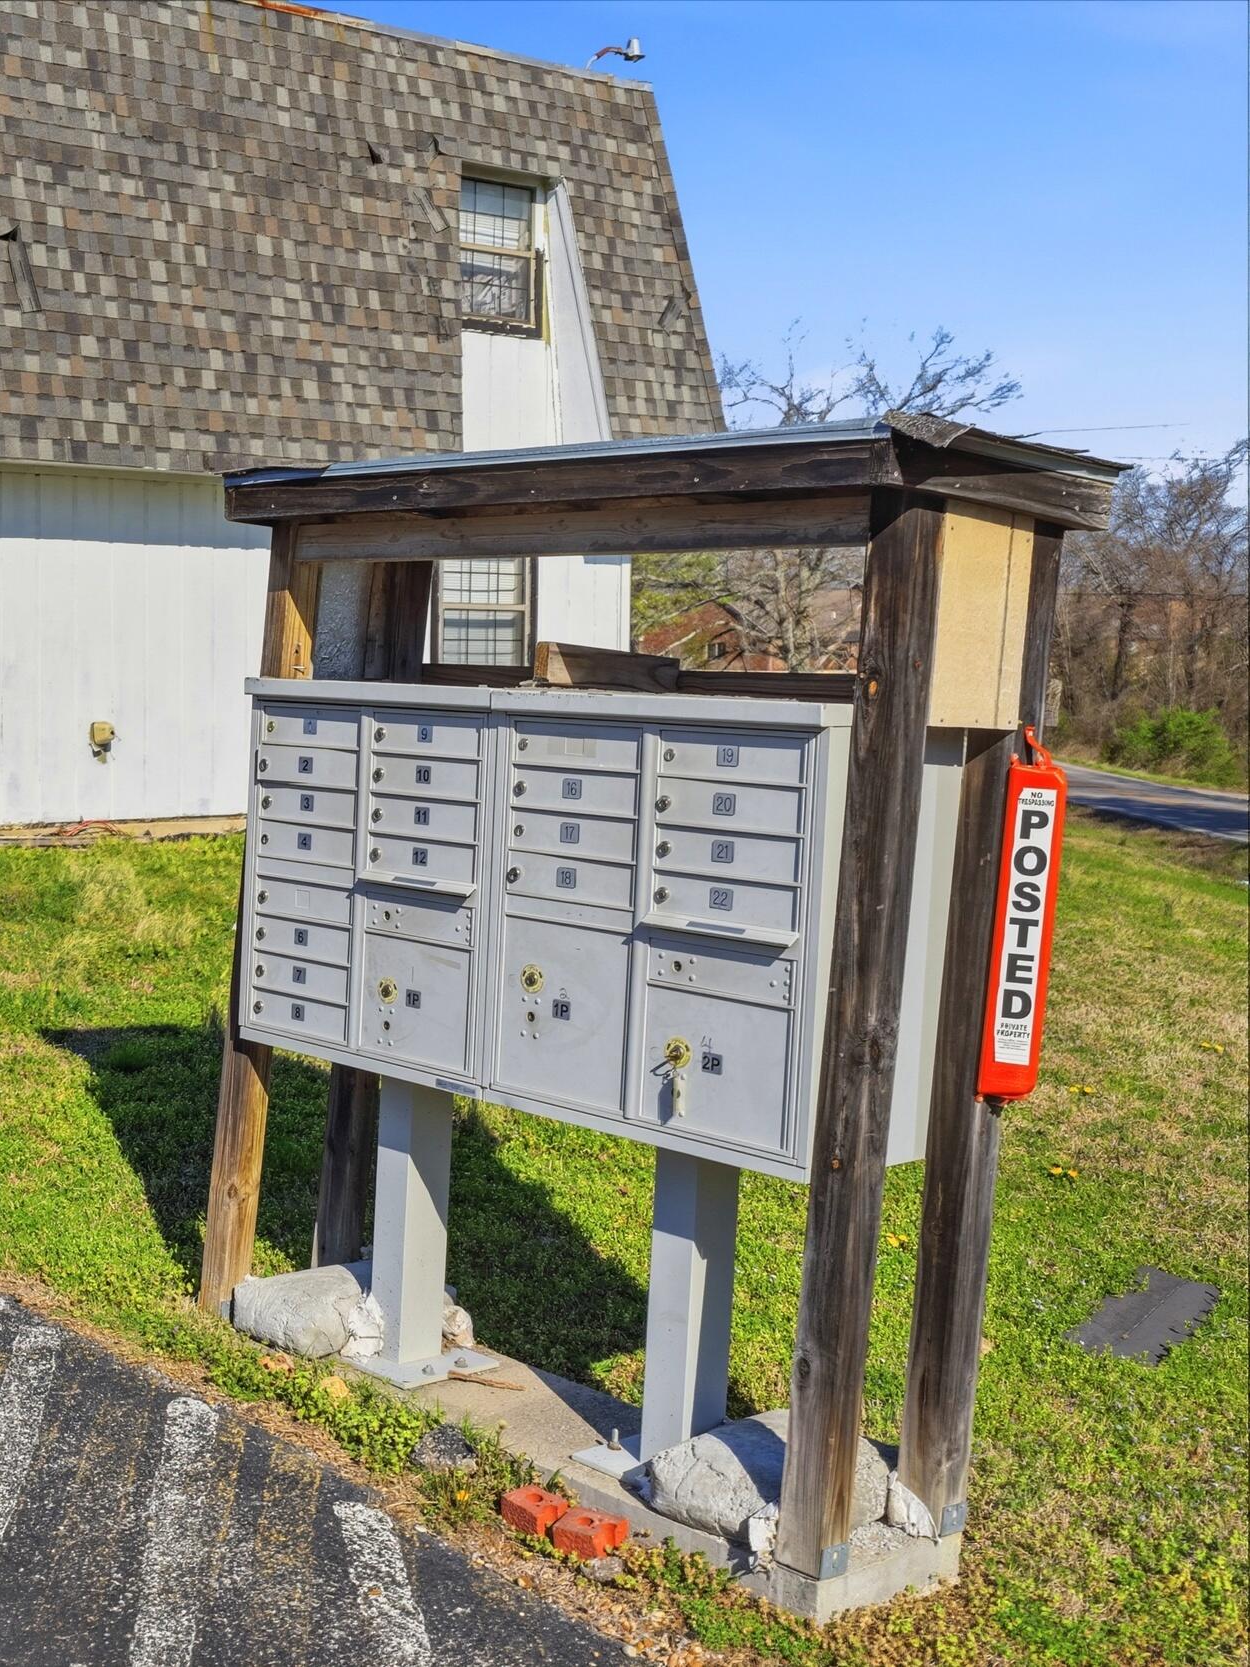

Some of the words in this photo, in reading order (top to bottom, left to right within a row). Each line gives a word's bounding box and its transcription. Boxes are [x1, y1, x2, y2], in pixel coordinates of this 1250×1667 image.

[1030, 791, 1043, 799] NO
[1001, 808, 1050, 1020] POSTED
[406, 992, 420, 1006] 1P
[553, 1002, 569, 1017] 1P
[1000, 1022, 1028, 1031] PRIVATE
[996, 1029, 1031, 1039] PROPERTY
[701, 1055, 720, 1071] 2P
